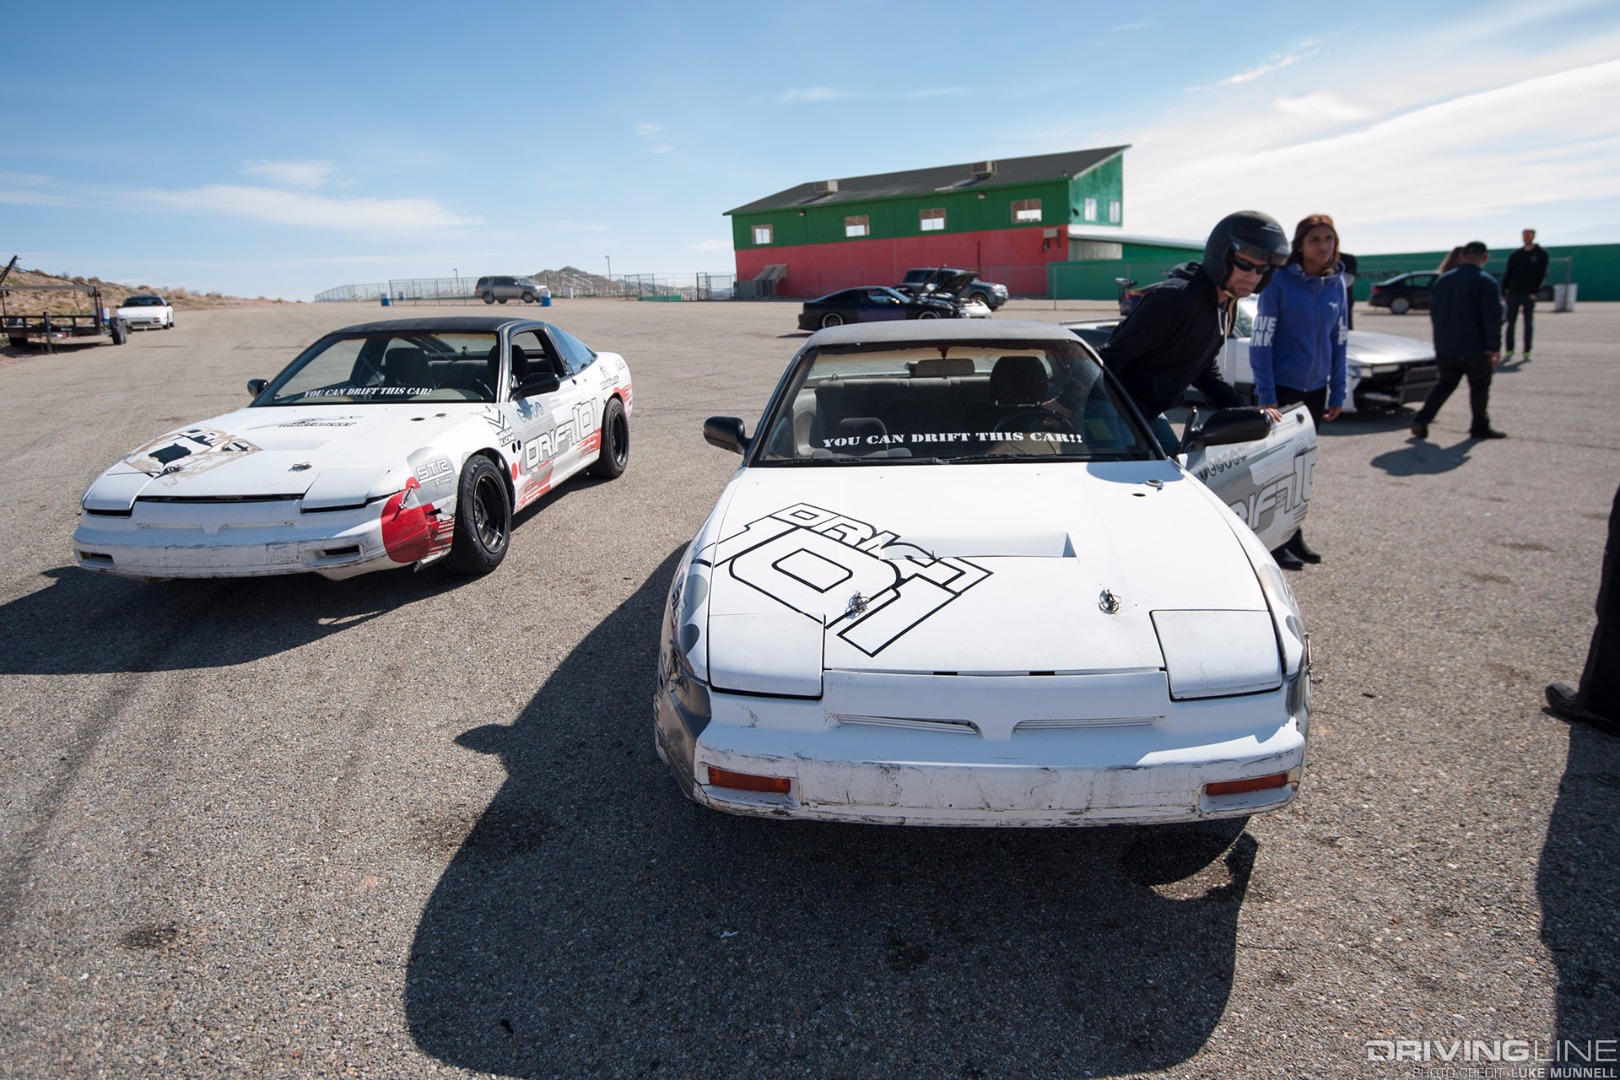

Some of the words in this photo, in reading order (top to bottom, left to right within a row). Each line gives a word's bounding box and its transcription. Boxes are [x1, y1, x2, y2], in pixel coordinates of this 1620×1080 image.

[1252, 316, 1277, 331] OVE
[1250, 331, 1273, 347] INK
[303, 390, 325, 398] YOU
[324, 388, 346, 397] CAN
[346, 387, 380, 396] DRIFT
[379, 387, 406, 396] THIS
[406, 387, 433, 396] CAR!
[822, 436, 861, 448] YOU
[866, 434, 905, 445] CAN
[911, 432, 971, 443] DRIFT
[975, 431, 1024, 442] THIS
[1029, 432, 1083, 444] CAR!!
